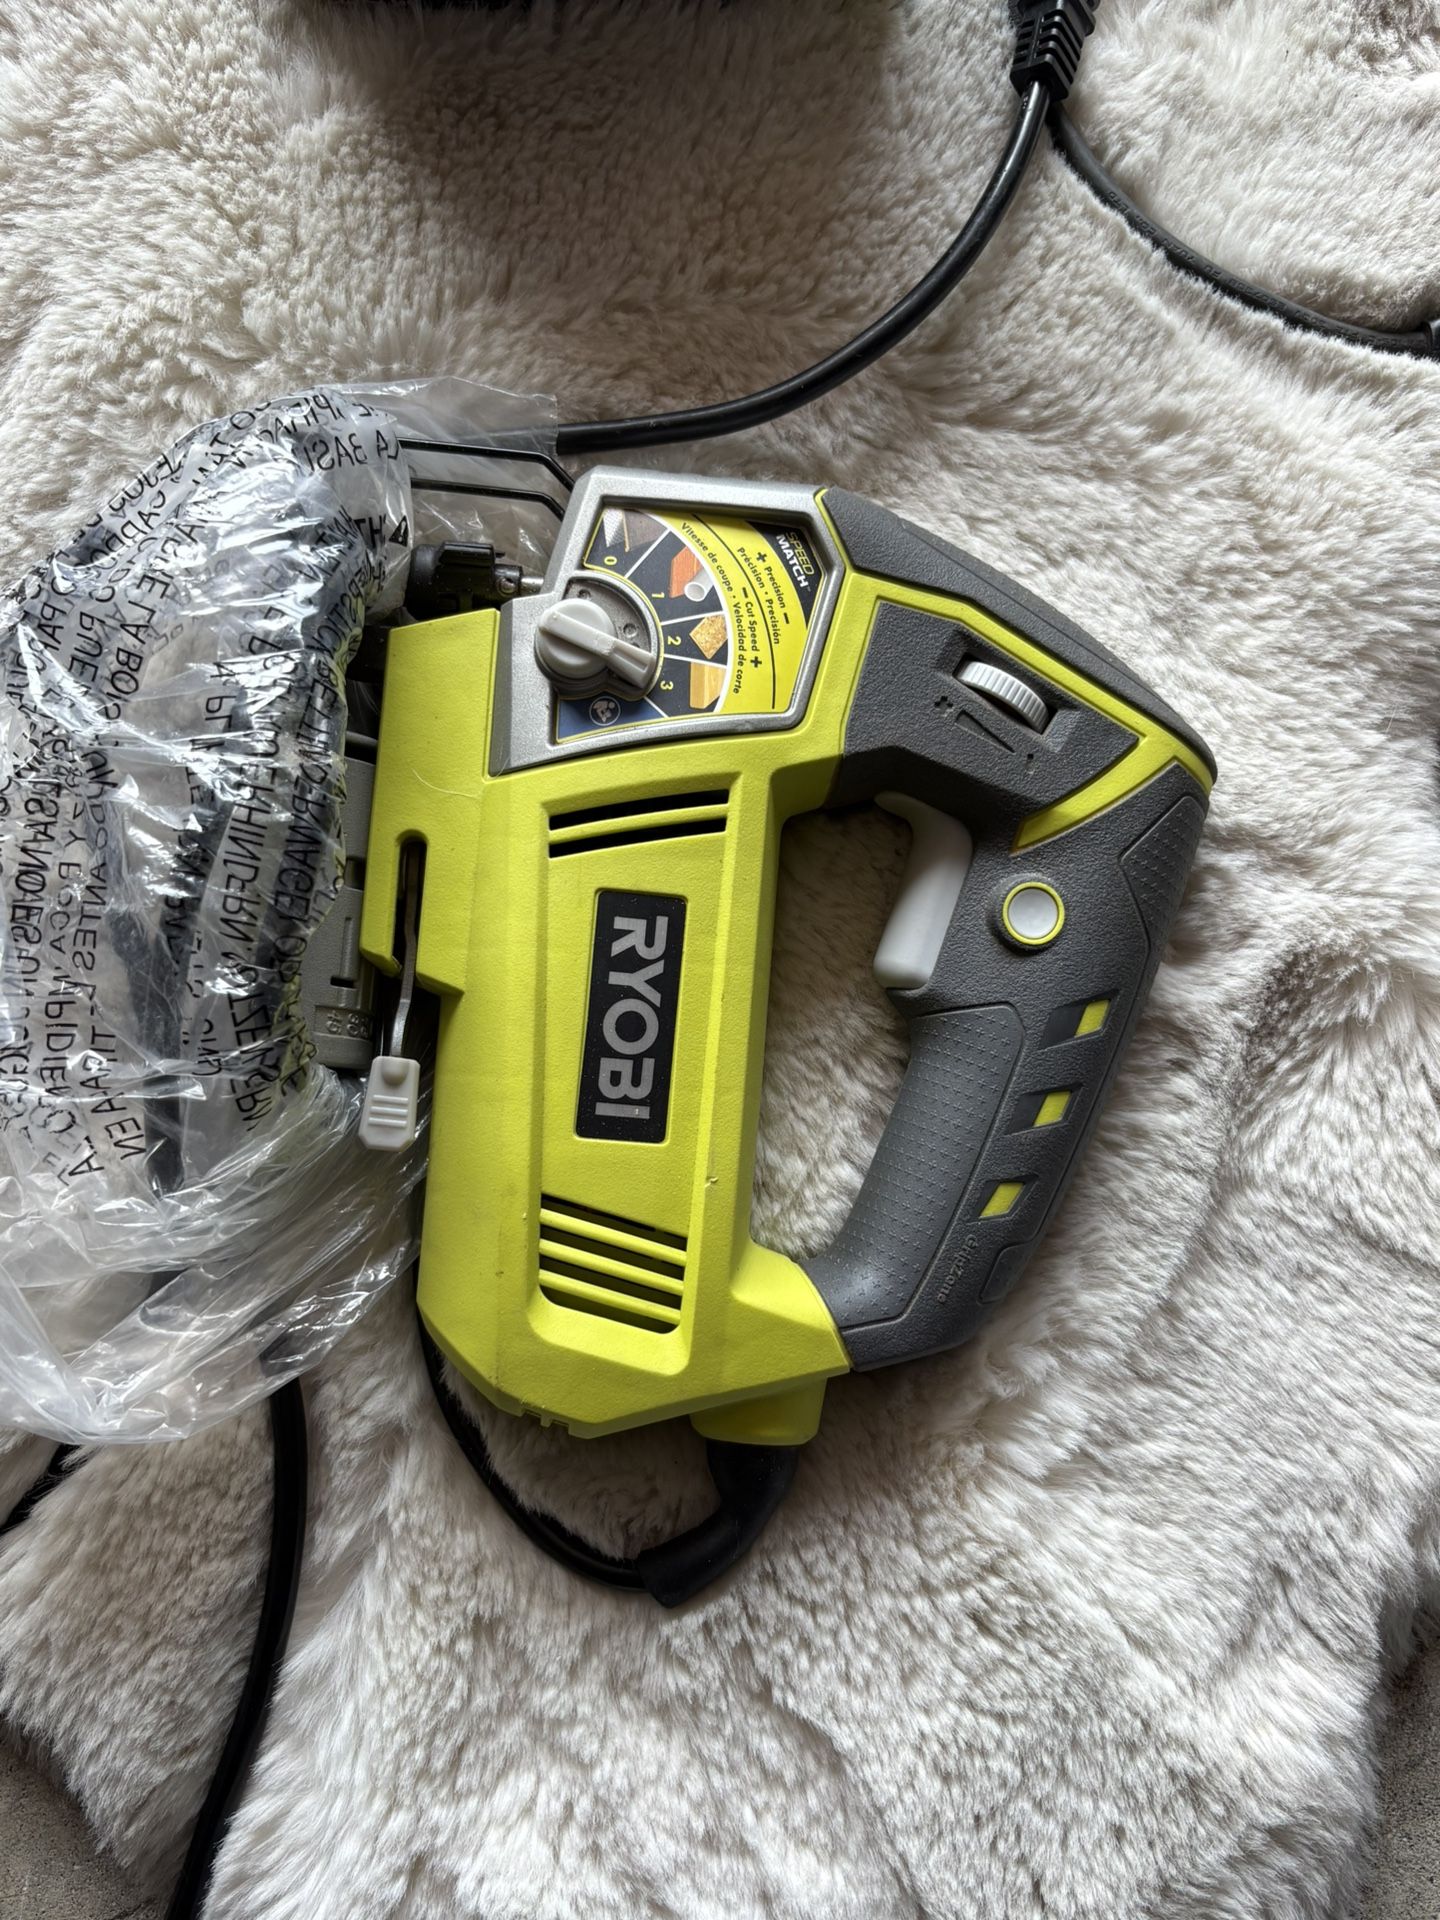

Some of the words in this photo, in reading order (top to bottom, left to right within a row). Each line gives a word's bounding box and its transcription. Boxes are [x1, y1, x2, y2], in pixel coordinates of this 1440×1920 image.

[681, 522, 709, 551] Vitesse
[604, 555, 618, 566] 0
[707, 552, 718, 564] de
[786, 532, 815, 575] SPEED
[716, 565, 733, 592] coupe
[764, 566, 786, 609] Precision
[651, 591, 665, 599] 1
[745, 601, 755, 617] Cut
[733, 602, 747, 652] Velocidad
[748, 620, 760, 652] Speed
[667, 636, 682, 646] 2
[737, 654, 747, 667] de
[660, 680, 674, 691] 3
[732, 670, 744, 694] corte
[595, 915, 669, 1120] RYOBI
